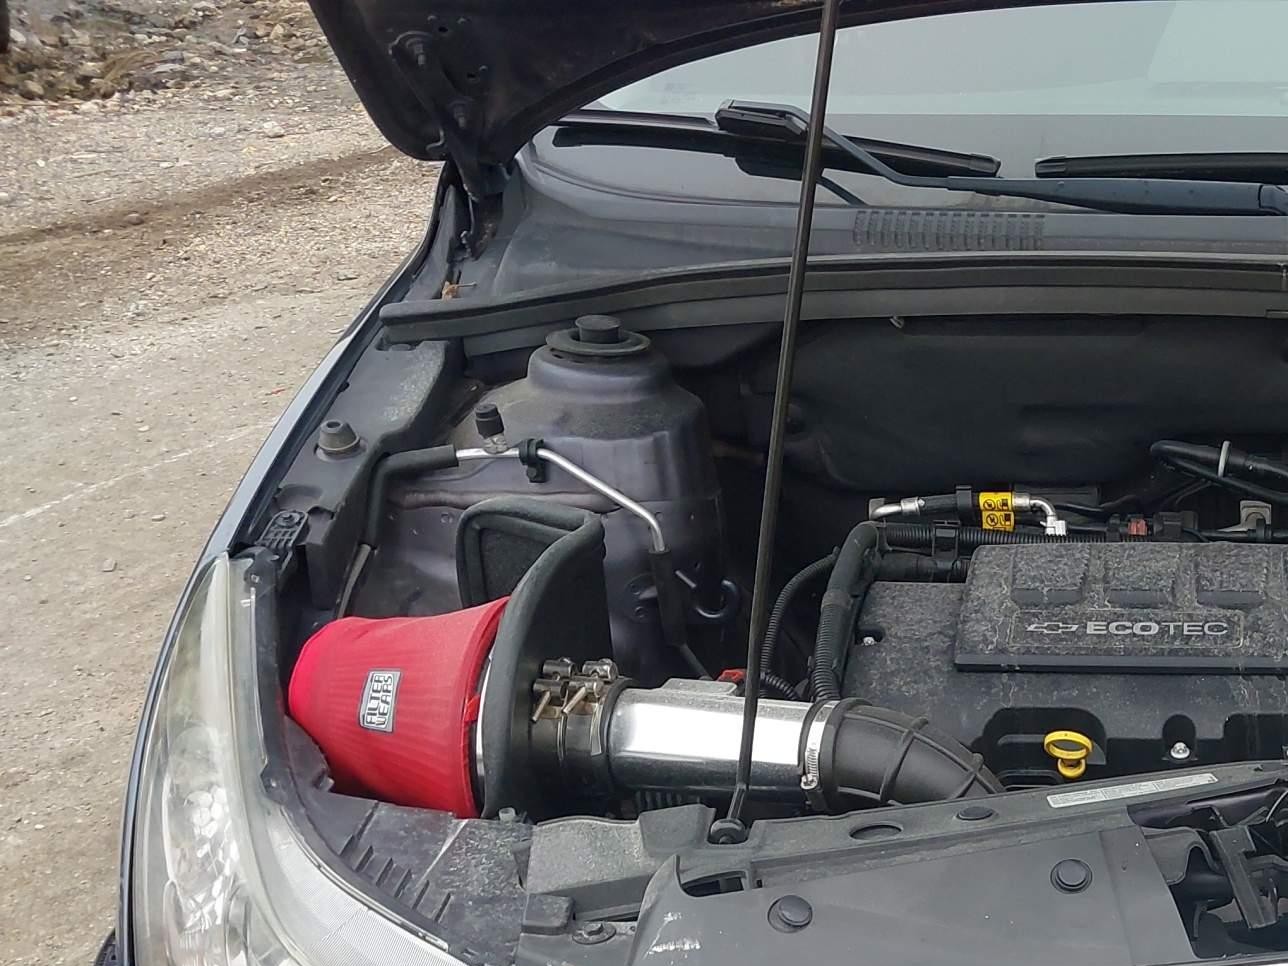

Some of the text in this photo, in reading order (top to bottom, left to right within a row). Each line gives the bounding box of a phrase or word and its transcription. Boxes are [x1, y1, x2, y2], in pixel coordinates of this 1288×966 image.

[1086, 620, 1230, 636] ECOTEC
[365, 674, 384, 725] FILTER
[375, 674, 393, 726] WEARS
